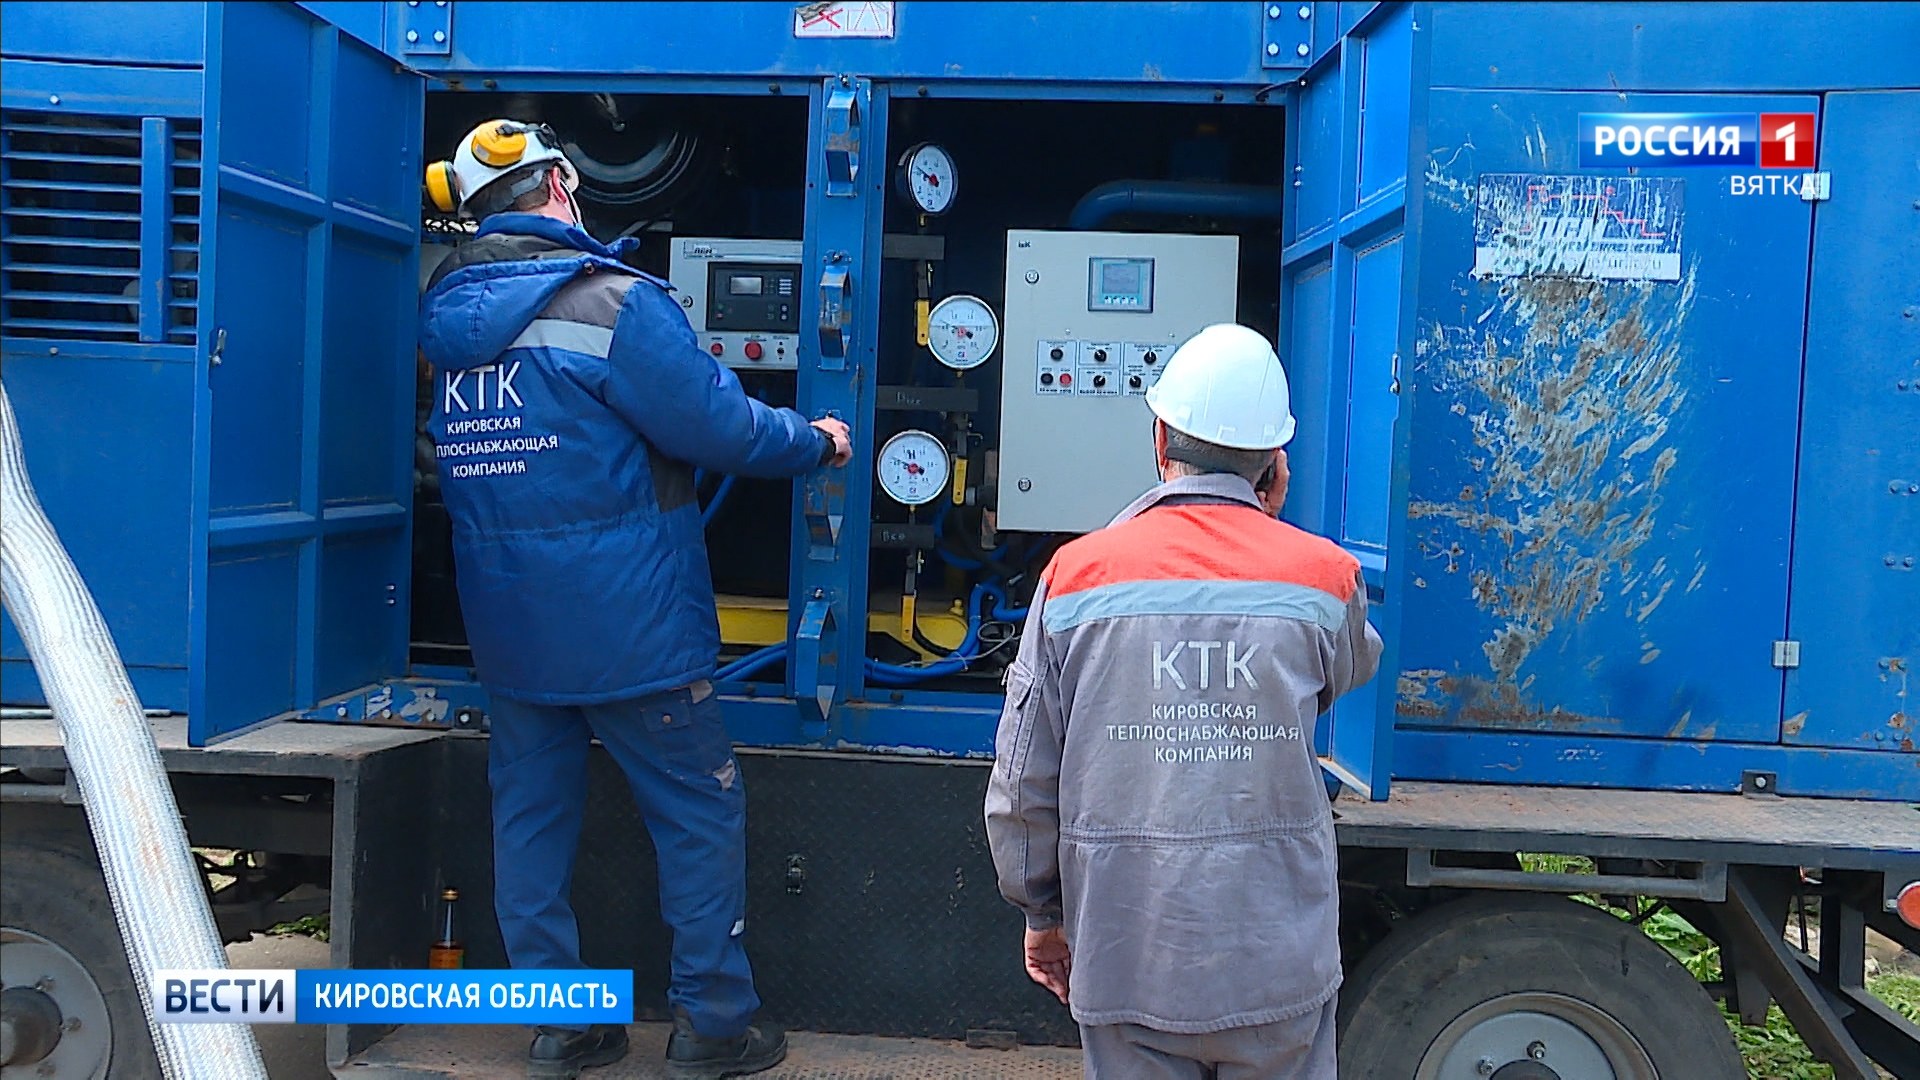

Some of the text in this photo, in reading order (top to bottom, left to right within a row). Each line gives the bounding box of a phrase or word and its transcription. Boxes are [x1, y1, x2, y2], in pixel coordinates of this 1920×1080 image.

[444, 361, 524, 414] КТК
[447, 416, 521, 435] КИРОВСКАЯ
[452, 460, 526, 478] КОМПАНИЯ
[1152, 641, 1261, 690] КТК
[1152, 703, 1257, 720] КИРОВСКАЯ
[1106, 724, 1299, 741] ТЕПЛОСНАБЖАЮЩАЯ
[1155, 745, 1253, 762] КОМПАНИЯ
